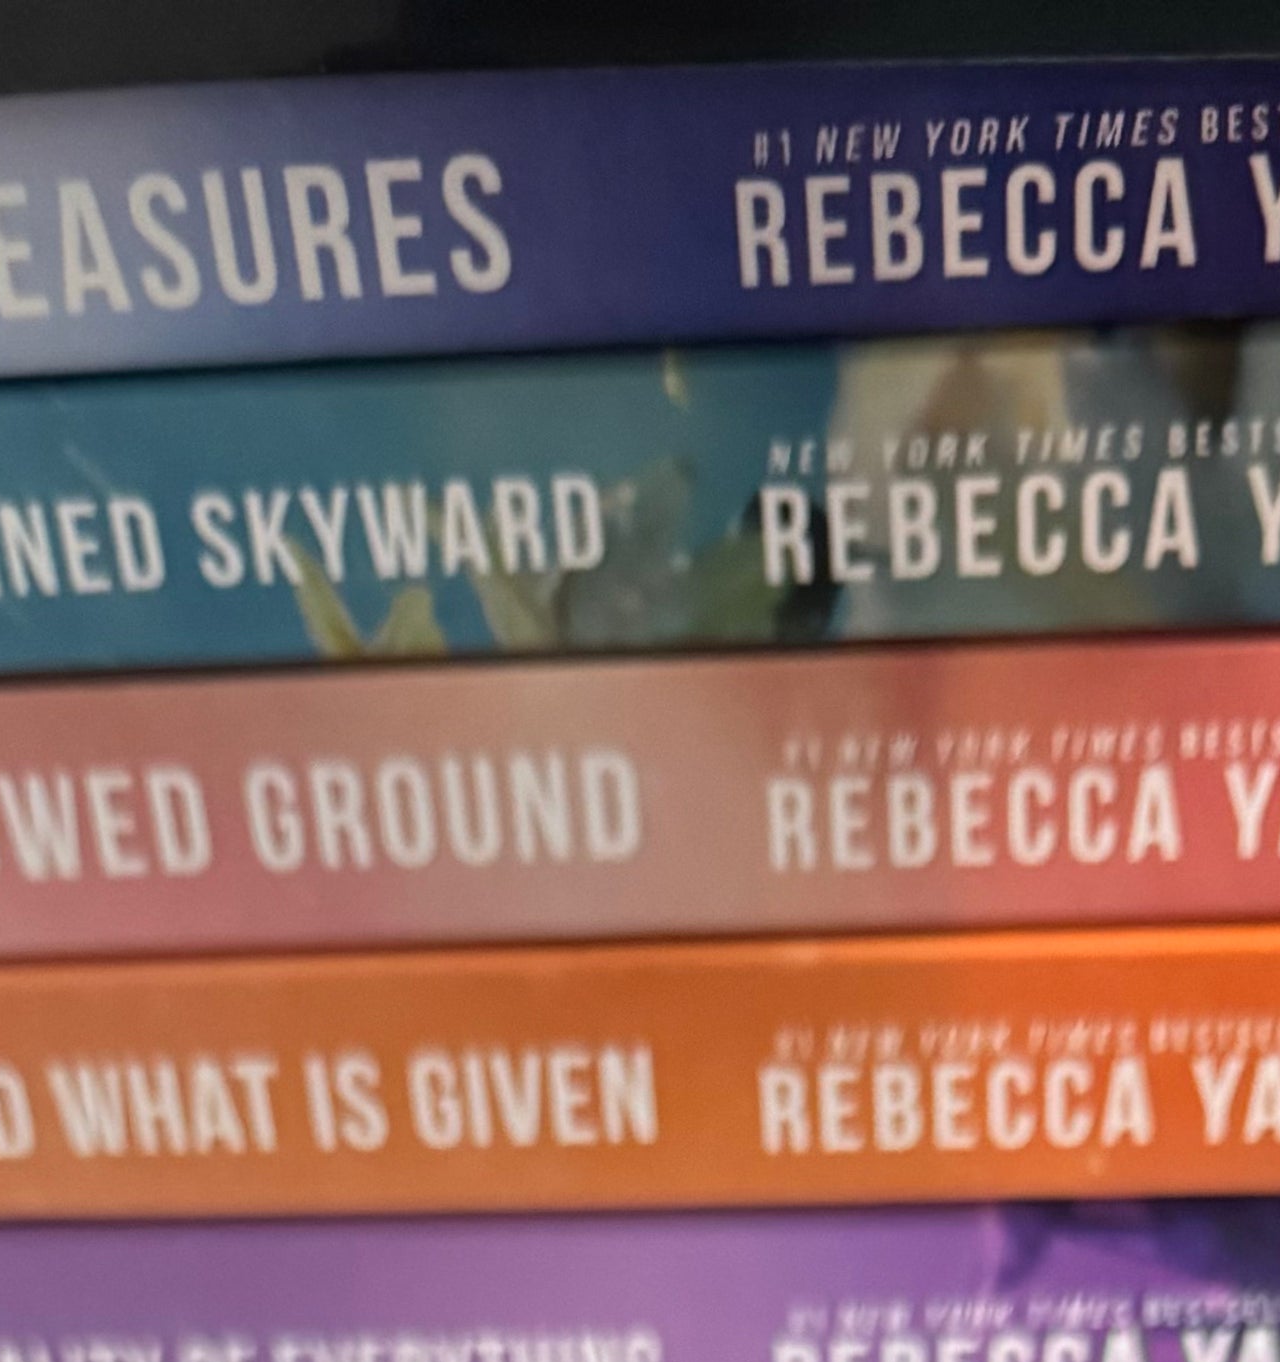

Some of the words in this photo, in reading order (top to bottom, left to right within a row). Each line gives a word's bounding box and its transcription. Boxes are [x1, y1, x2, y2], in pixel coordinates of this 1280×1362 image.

[753, 126, 793, 170] #1
[816, 120, 901, 164] NEW
[925, 113, 1030, 156] YORK
[1053, 105, 1181, 151] TIMES
[733, 154, 1197, 288] REBECCA
[768, 434, 854, 476] NEW
[885, 430, 988, 470] YORK
[1017, 422, 1144, 466] TIMES
[190, 472, 607, 588] SKYWARD
[760, 463, 1198, 587] REBECCA
[244, 748, 644, 873] GROUND
[765, 763, 1184, 872] REBECCA
[46, 1049, 280, 1158] WHAT
[302, 1046, 390, 1153] IS
[406, 1041, 660, 1149] GIVEN
[757, 1051, 1156, 1157] REBECCA
